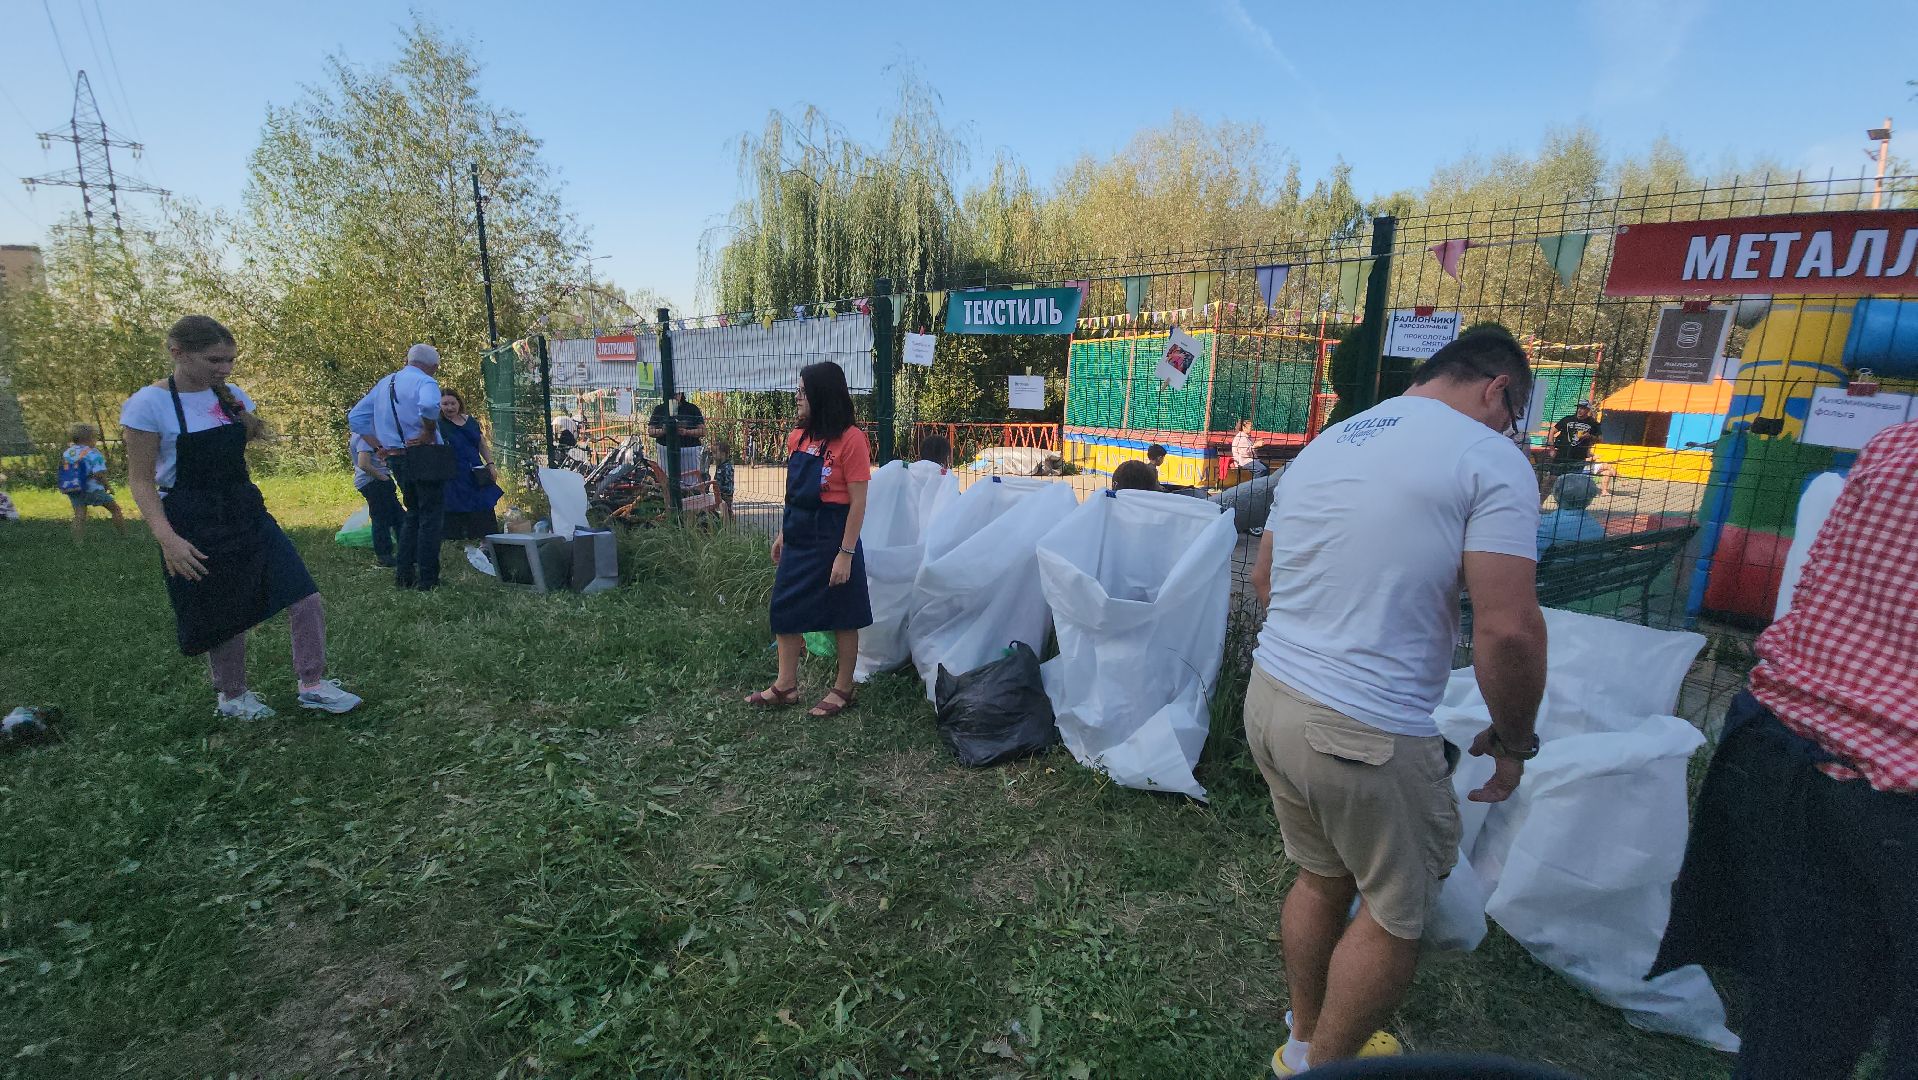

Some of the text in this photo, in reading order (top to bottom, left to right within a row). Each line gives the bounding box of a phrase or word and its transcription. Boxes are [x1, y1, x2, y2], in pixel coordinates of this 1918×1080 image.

[963, 297, 1063, 326] ТЕКСТИЛЬ
[1394, 315, 1456, 324] БАЛЛОНЧИКИ
[1814, 407, 1855, 419] фольга
